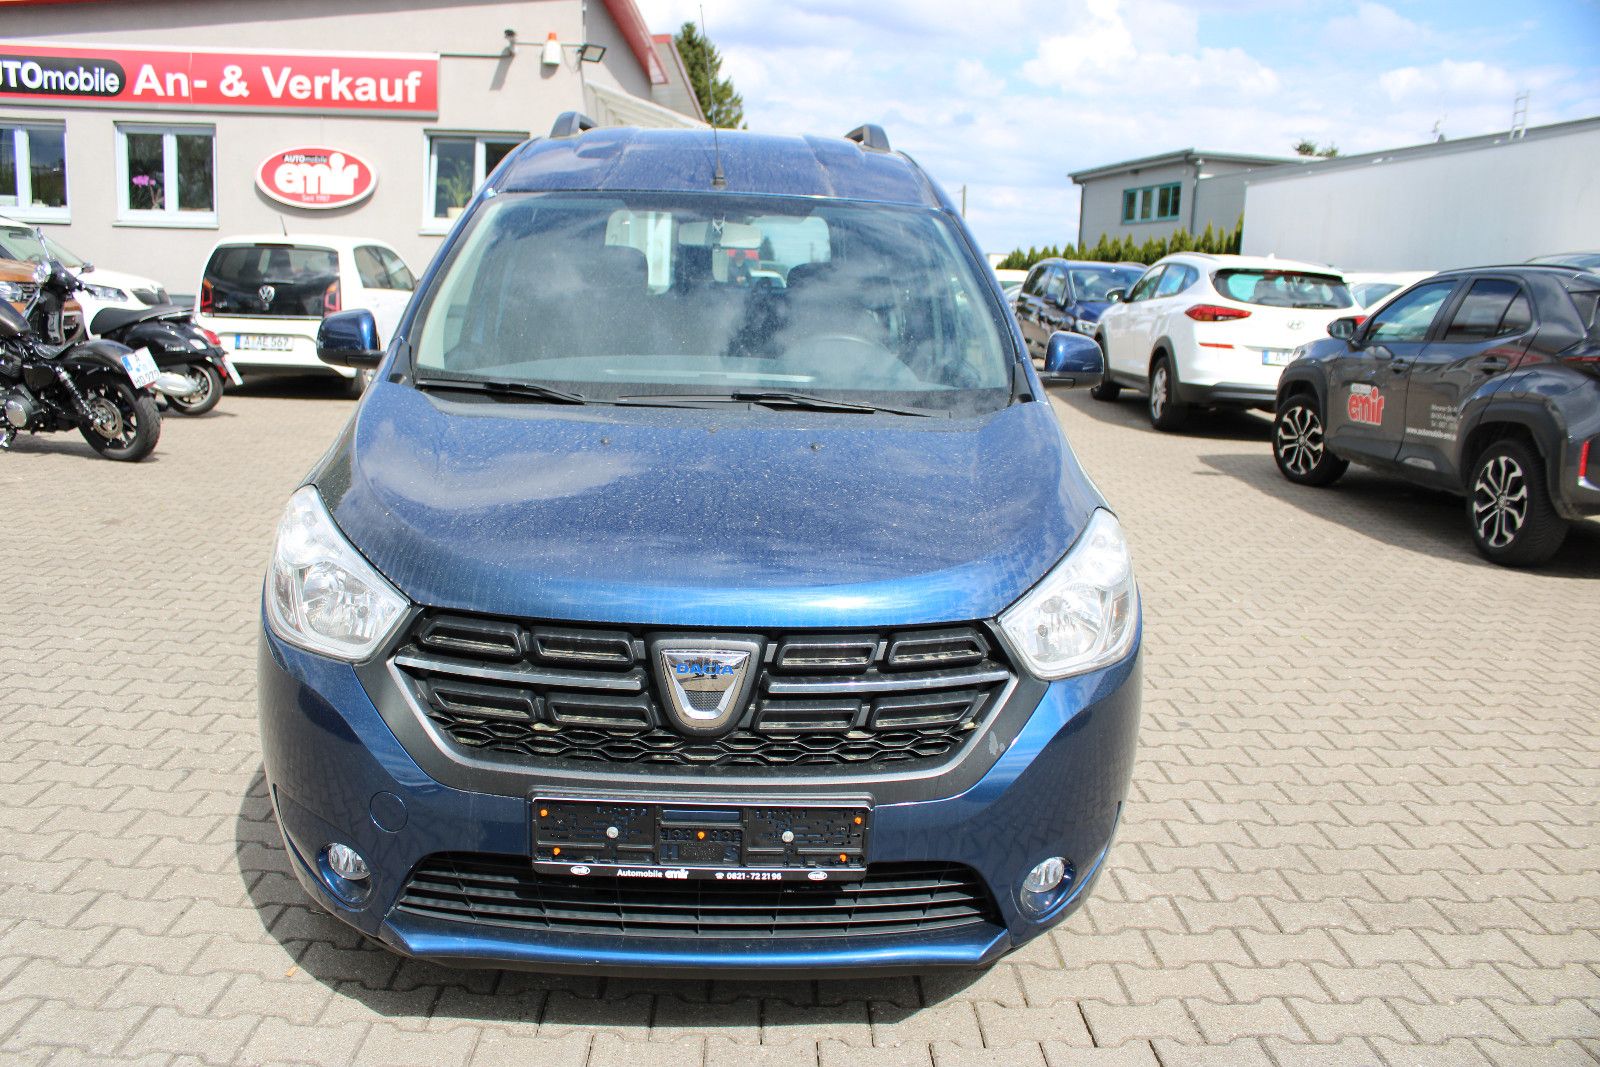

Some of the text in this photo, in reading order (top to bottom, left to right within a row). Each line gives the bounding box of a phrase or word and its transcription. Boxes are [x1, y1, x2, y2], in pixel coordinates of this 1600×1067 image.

[133, 64, 207, 97] An-
[219, 65, 250, 98] &
[261, 66, 423, 103] Verkauf
[274, 152, 359, 195] emir
[1348, 386, 1385, 426] emir
[676, 663, 734, 675] DACIA
[617, 867, 689, 879] Automobile emir
